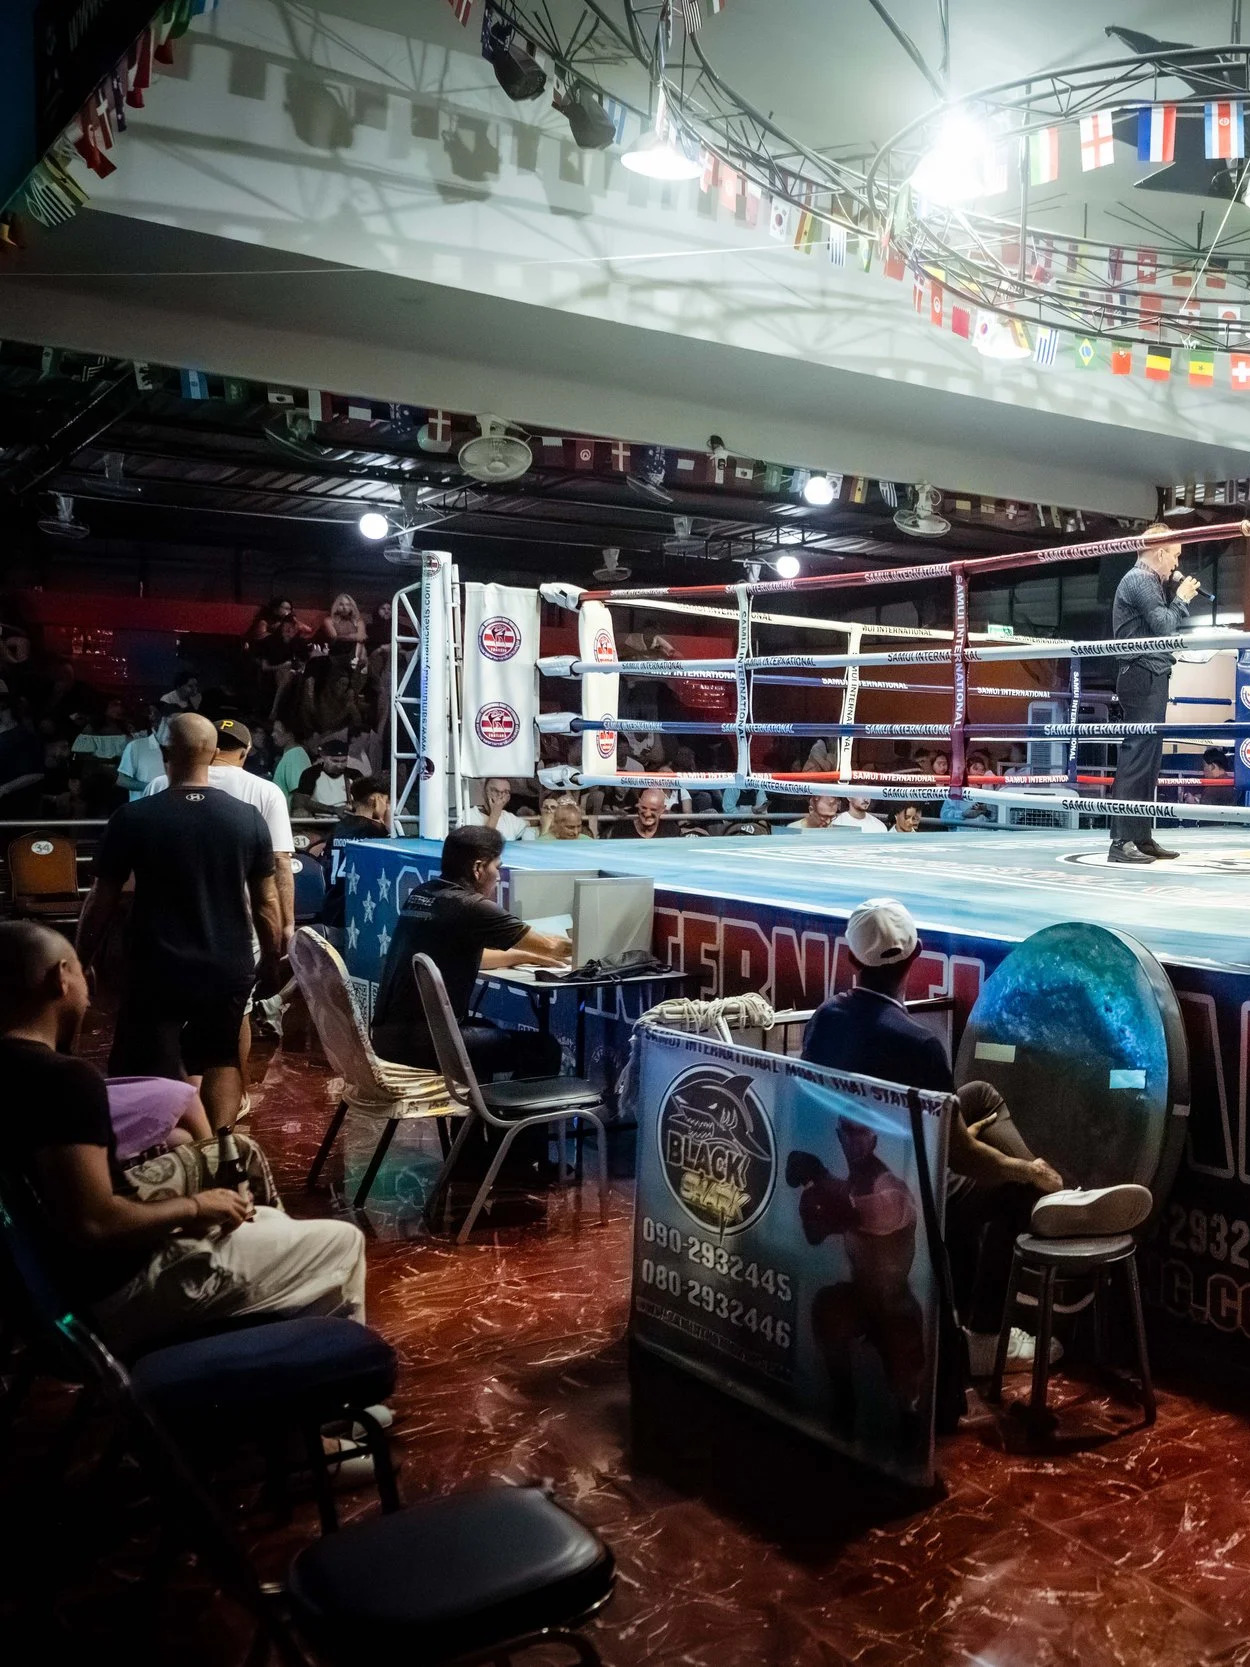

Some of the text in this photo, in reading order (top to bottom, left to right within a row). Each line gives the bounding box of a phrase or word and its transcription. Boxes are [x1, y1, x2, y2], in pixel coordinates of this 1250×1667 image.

[1037, 539, 1148, 562] SAMUI INTERNATIONAL
[864, 563, 952, 583] SAMUI INTERNATIONAL
[739, 611, 748, 650] SAMUI
[953, 575, 965, 729] SAMUI INTERNATIONAL
[1070, 638, 1189, 656] SAMUI INTERNATIONAL
[887, 650, 982, 663] SAMUI INTERNANAL
[673, 671, 737, 680] INTERNATIONA
[858, 680, 909, 690] TERNATIONAL
[977, 686, 1051, 698] SAMUI INTERNATIONAL
[220, 720, 234, 731] P
[843, 685, 858, 752] INTERNANAL
[865, 724, 951, 735] SAMUI INTERNATIONA
[1044, 723, 1158, 736] SAMUI INTERNATIONAL
[1069, 699, 1078, 761] INTERIONAL
[853, 770, 937, 783] SAMUI INTERNATIONAL
[1004, 775, 1069, 783] SAMUI INTERNATION
[1157, 777, 1202, 785] INTERNATIONAL
[760, 780, 813, 794] INTERNATIONAL
[882, 787, 974, 802] SAMUI INTERNATAL
[1062, 799, 1178, 818] SAMUI INTERNATIONAL
[294, 837, 307, 847] 31
[667, 1130, 751, 1190] BLACK
[643, 1216, 792, 1302] 090-2932445
[641, 1258, 791, 1350] 080-2932446
